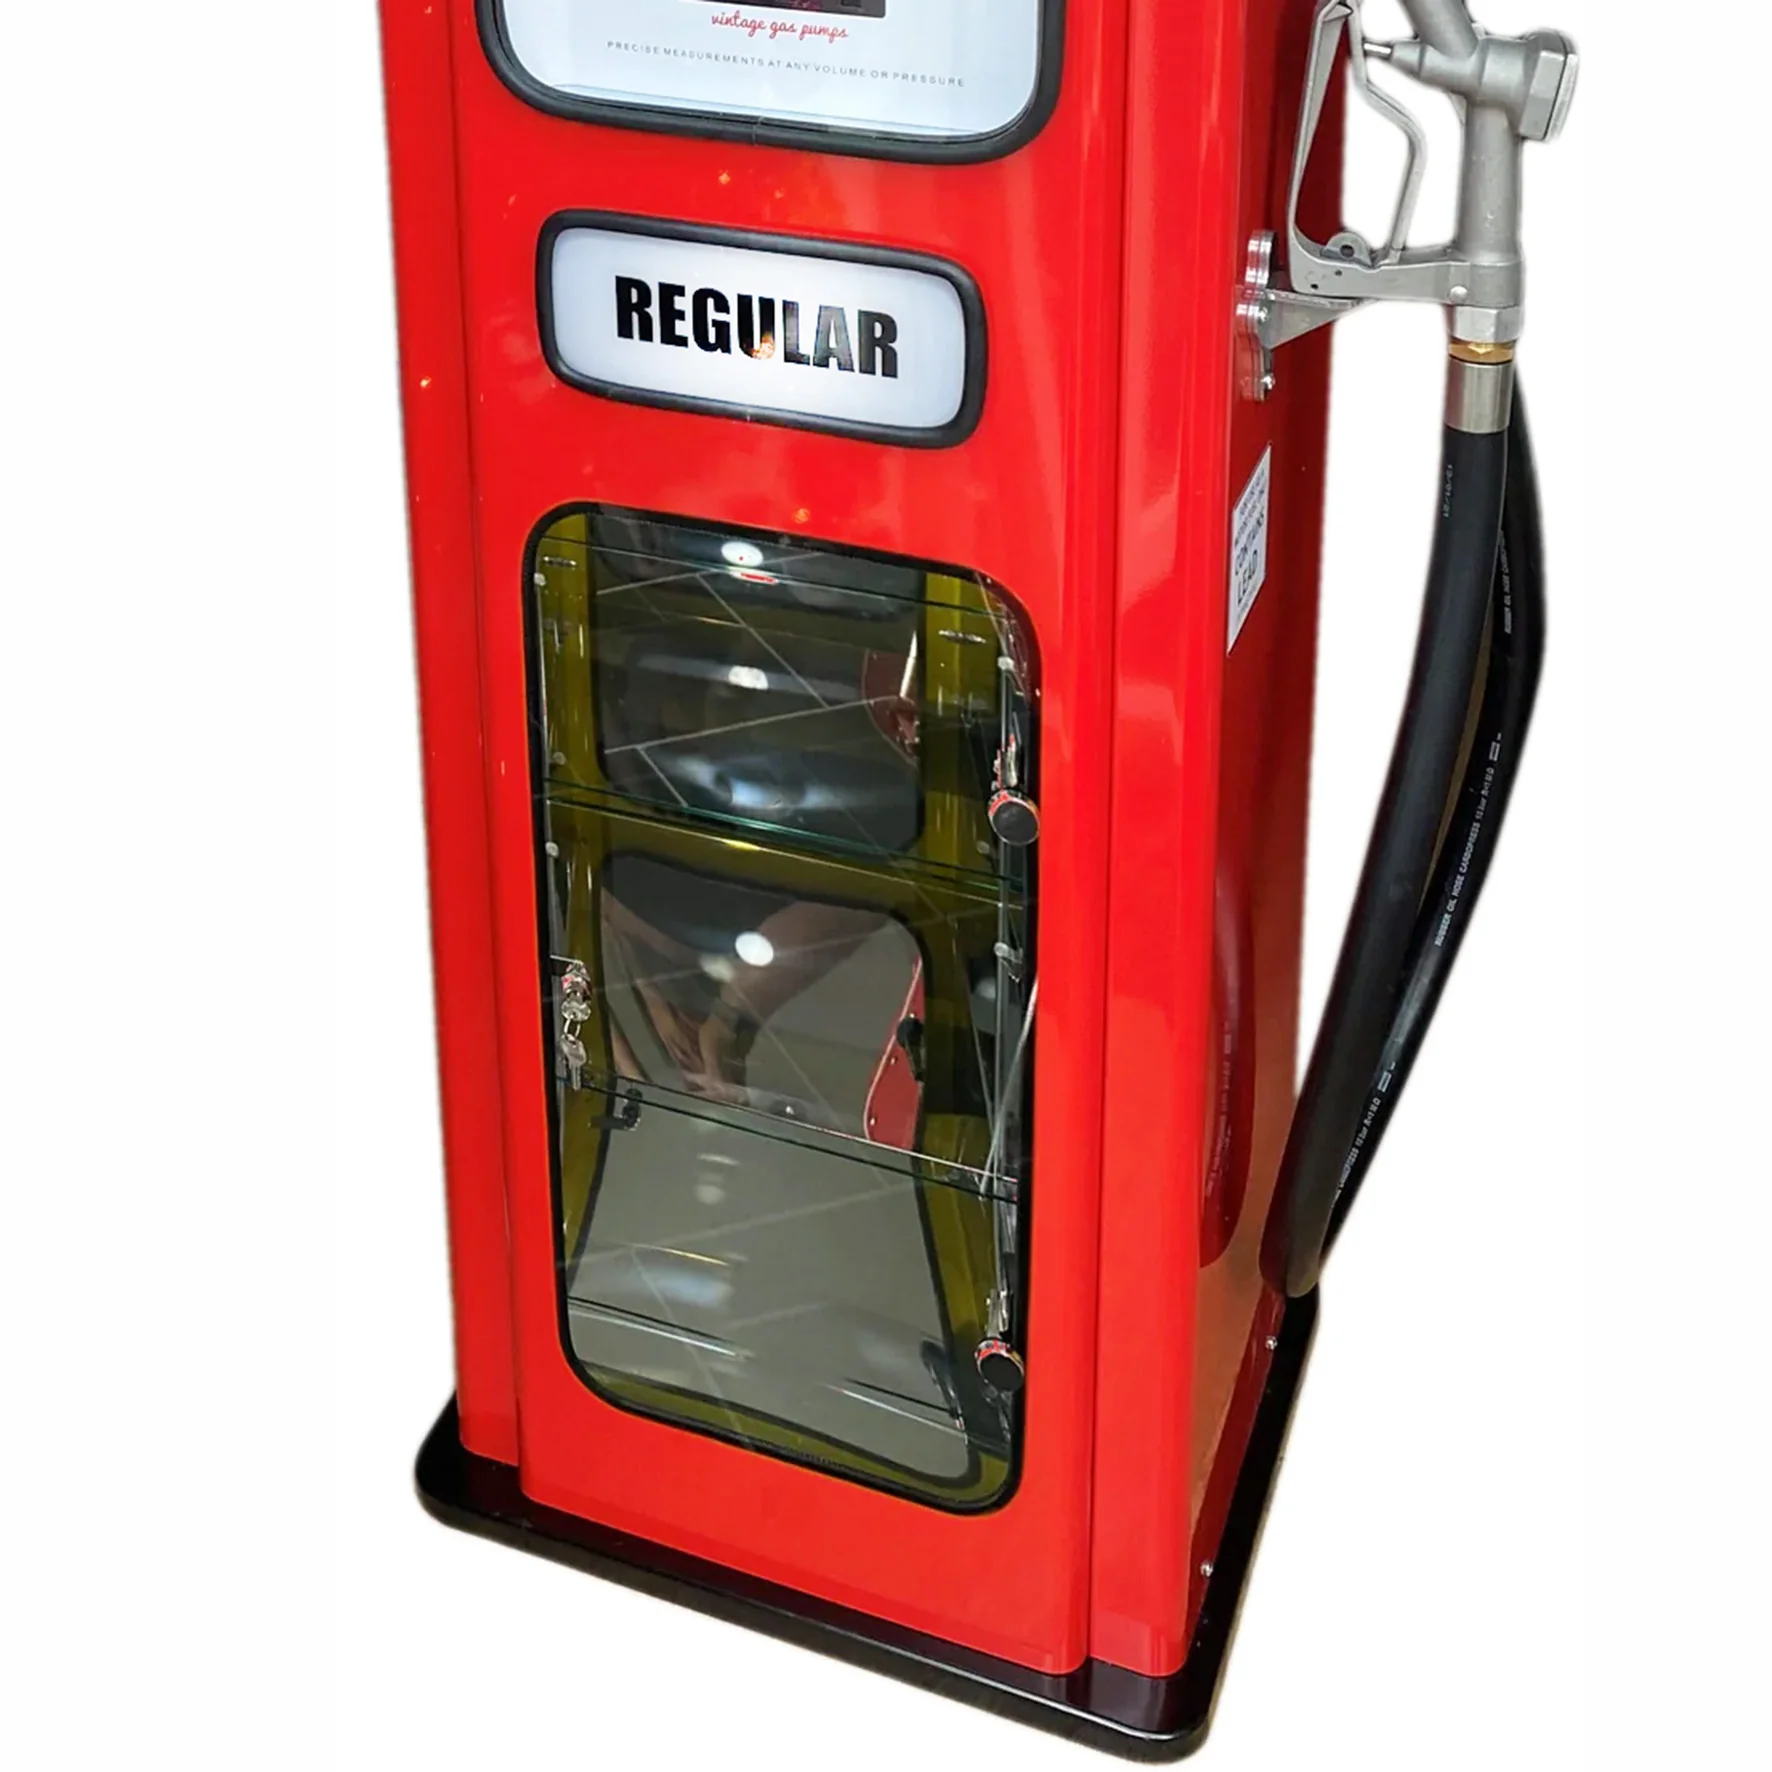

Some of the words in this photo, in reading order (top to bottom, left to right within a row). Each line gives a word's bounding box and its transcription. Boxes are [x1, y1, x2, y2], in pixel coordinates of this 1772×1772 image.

[711, 10, 766, 37] vintage
[769, 20, 797, 39] gas
[800, 23, 848, 43] pumps
[607, 40, 659, 54] PRECISE
[663, 47, 764, 66] MEASUREMENTS
[768, 59, 781, 68] AT
[785, 61, 810, 71] ANY
[814, 64, 866, 77] VOLUME
[870, 69, 888, 79] OR
[893, 71, 964, 87] PRESSURE
[615, 275, 899, 379] REGULAR
[1238, 549, 1258, 607] LEAD
